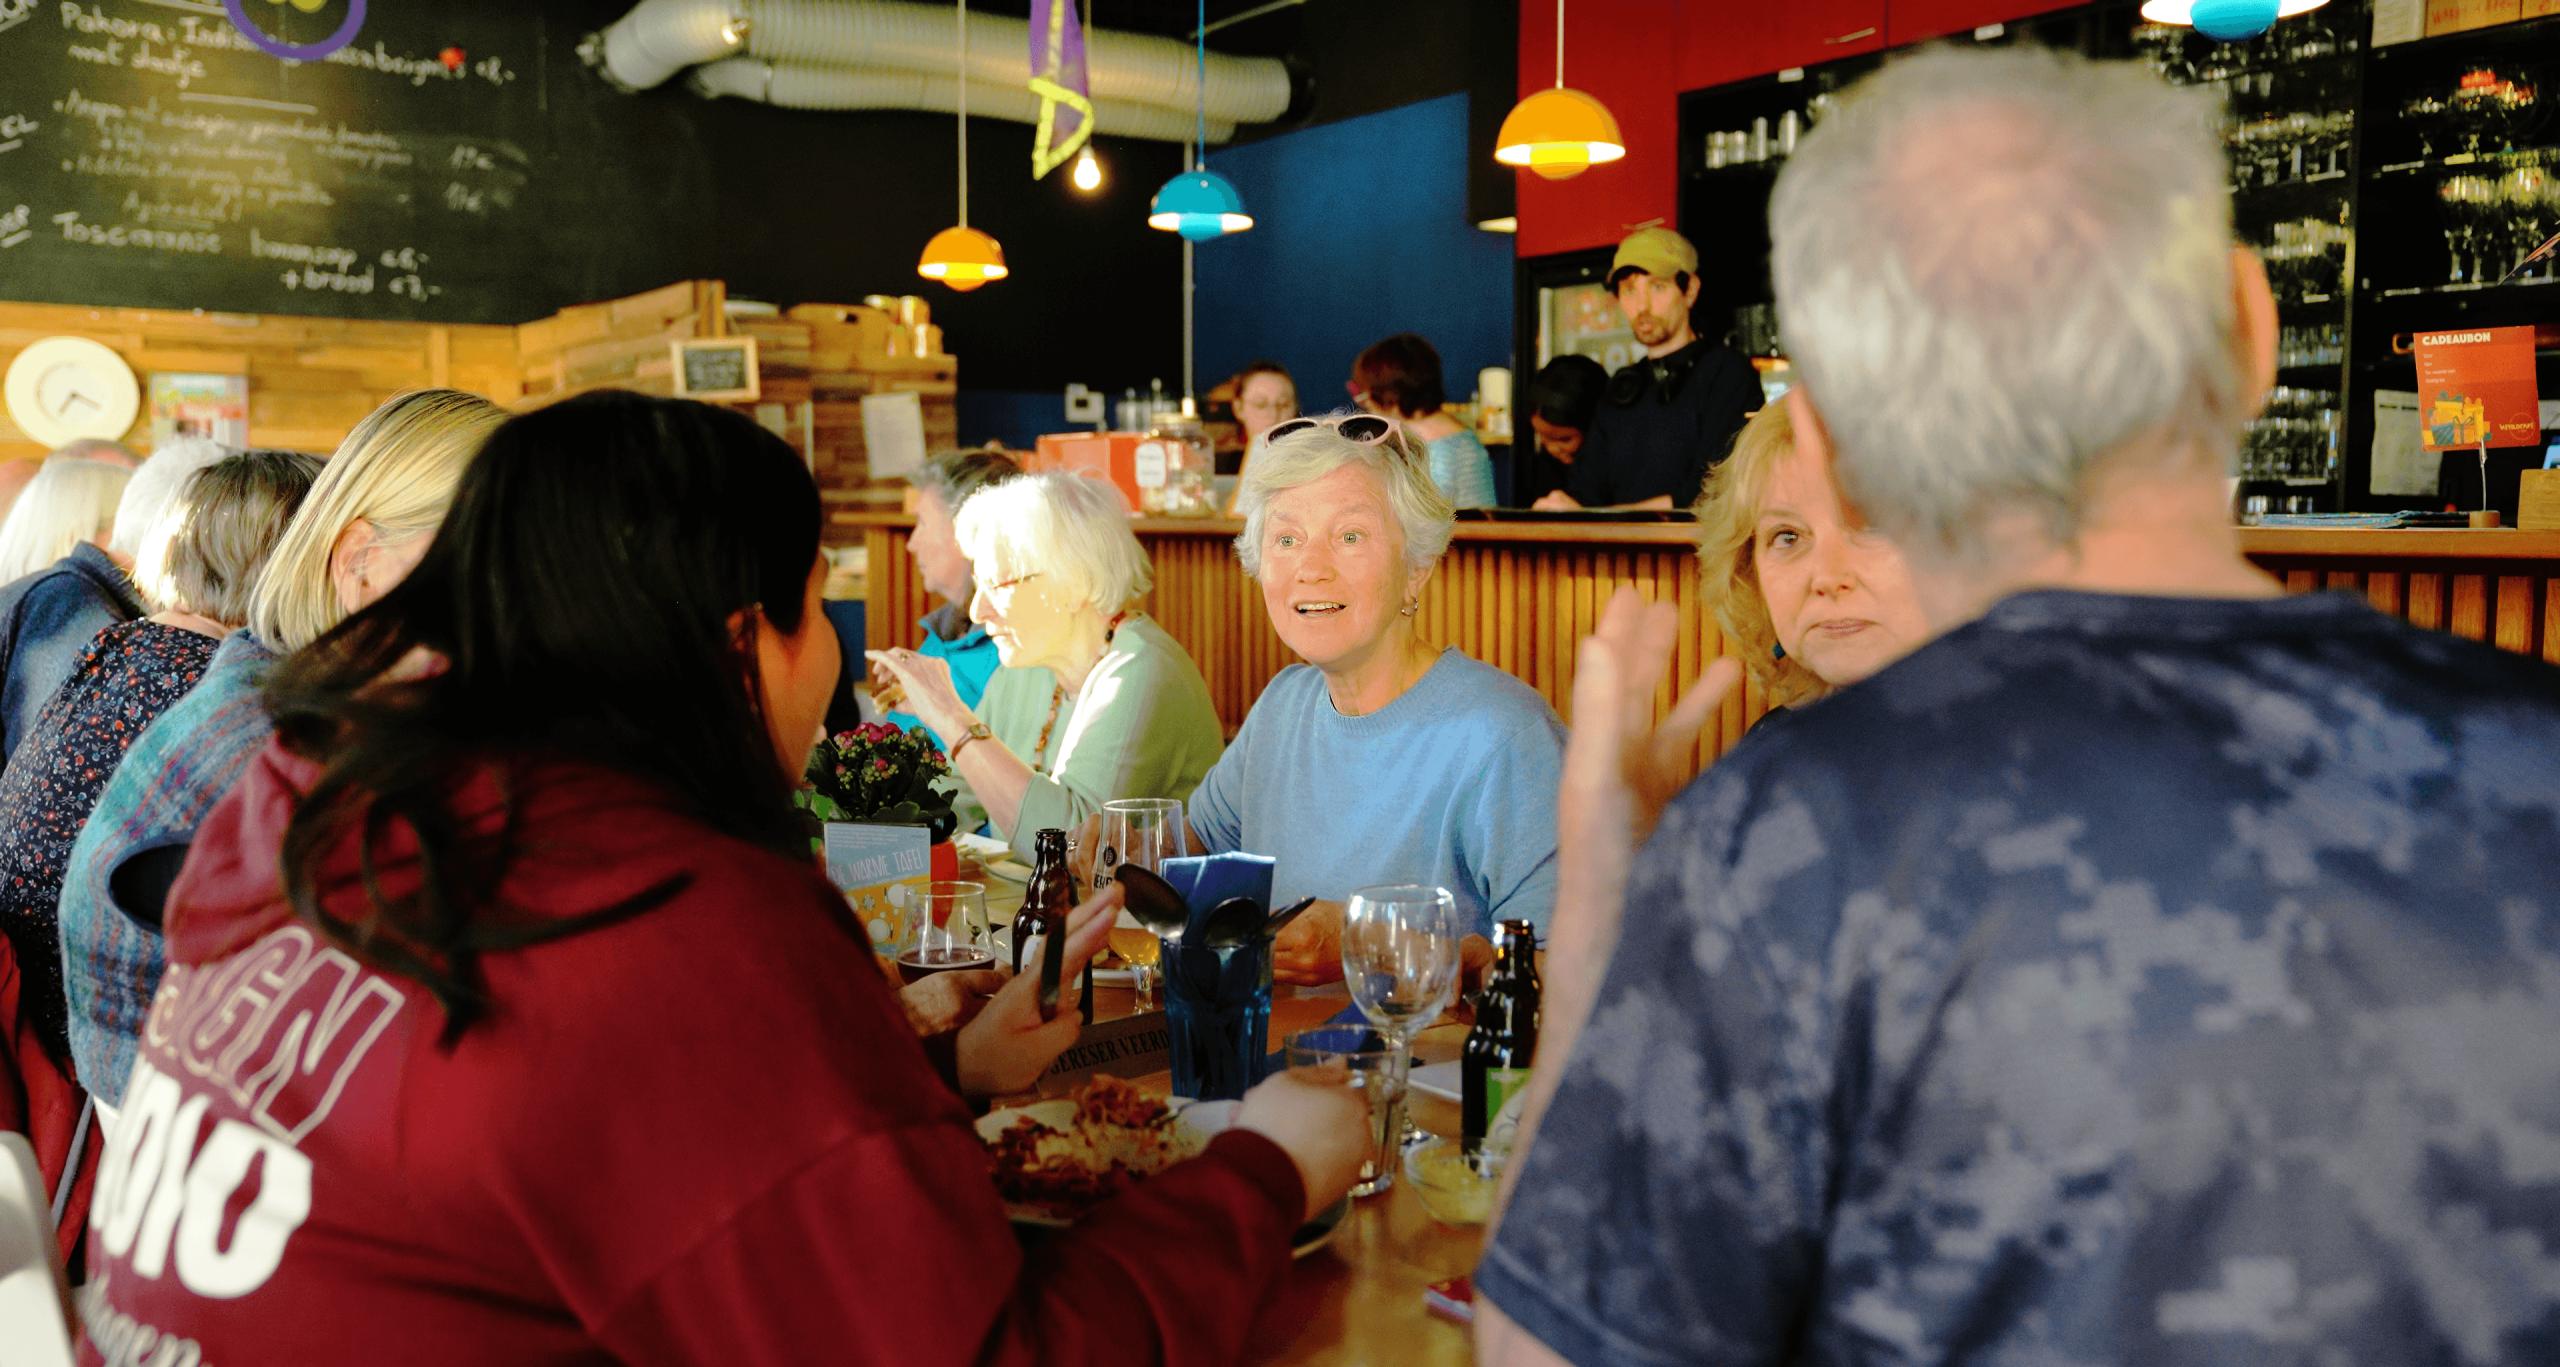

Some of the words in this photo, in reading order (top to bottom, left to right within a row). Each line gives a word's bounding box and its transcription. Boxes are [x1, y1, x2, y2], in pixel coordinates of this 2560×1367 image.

[68, 37, 123, 66] met
[52, 211, 222, 253] Toscaanse
[303, 263, 374, 294] brood
[2422, 332, 2491, 346] CADEAUBON
[848, 854, 891, 882] WARME
[892, 846, 924, 873] TAFEL
